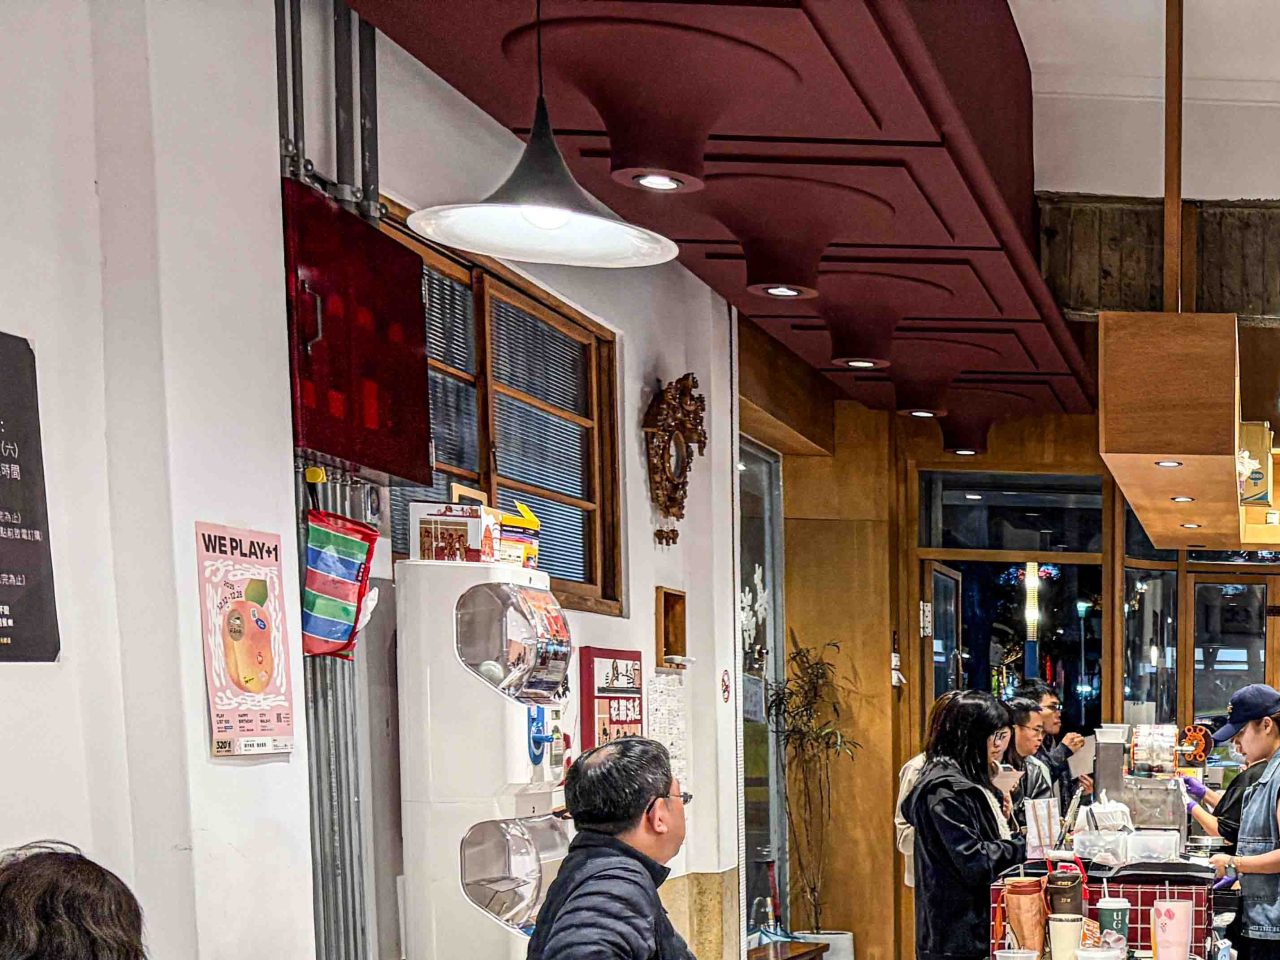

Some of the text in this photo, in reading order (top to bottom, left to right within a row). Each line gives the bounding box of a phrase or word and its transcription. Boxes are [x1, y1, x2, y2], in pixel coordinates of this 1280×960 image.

[0, 463, 21, 481] 時間
[201, 533, 279, 562] WE PLAY+1
[0, 573, 26, 586] 完為止)
